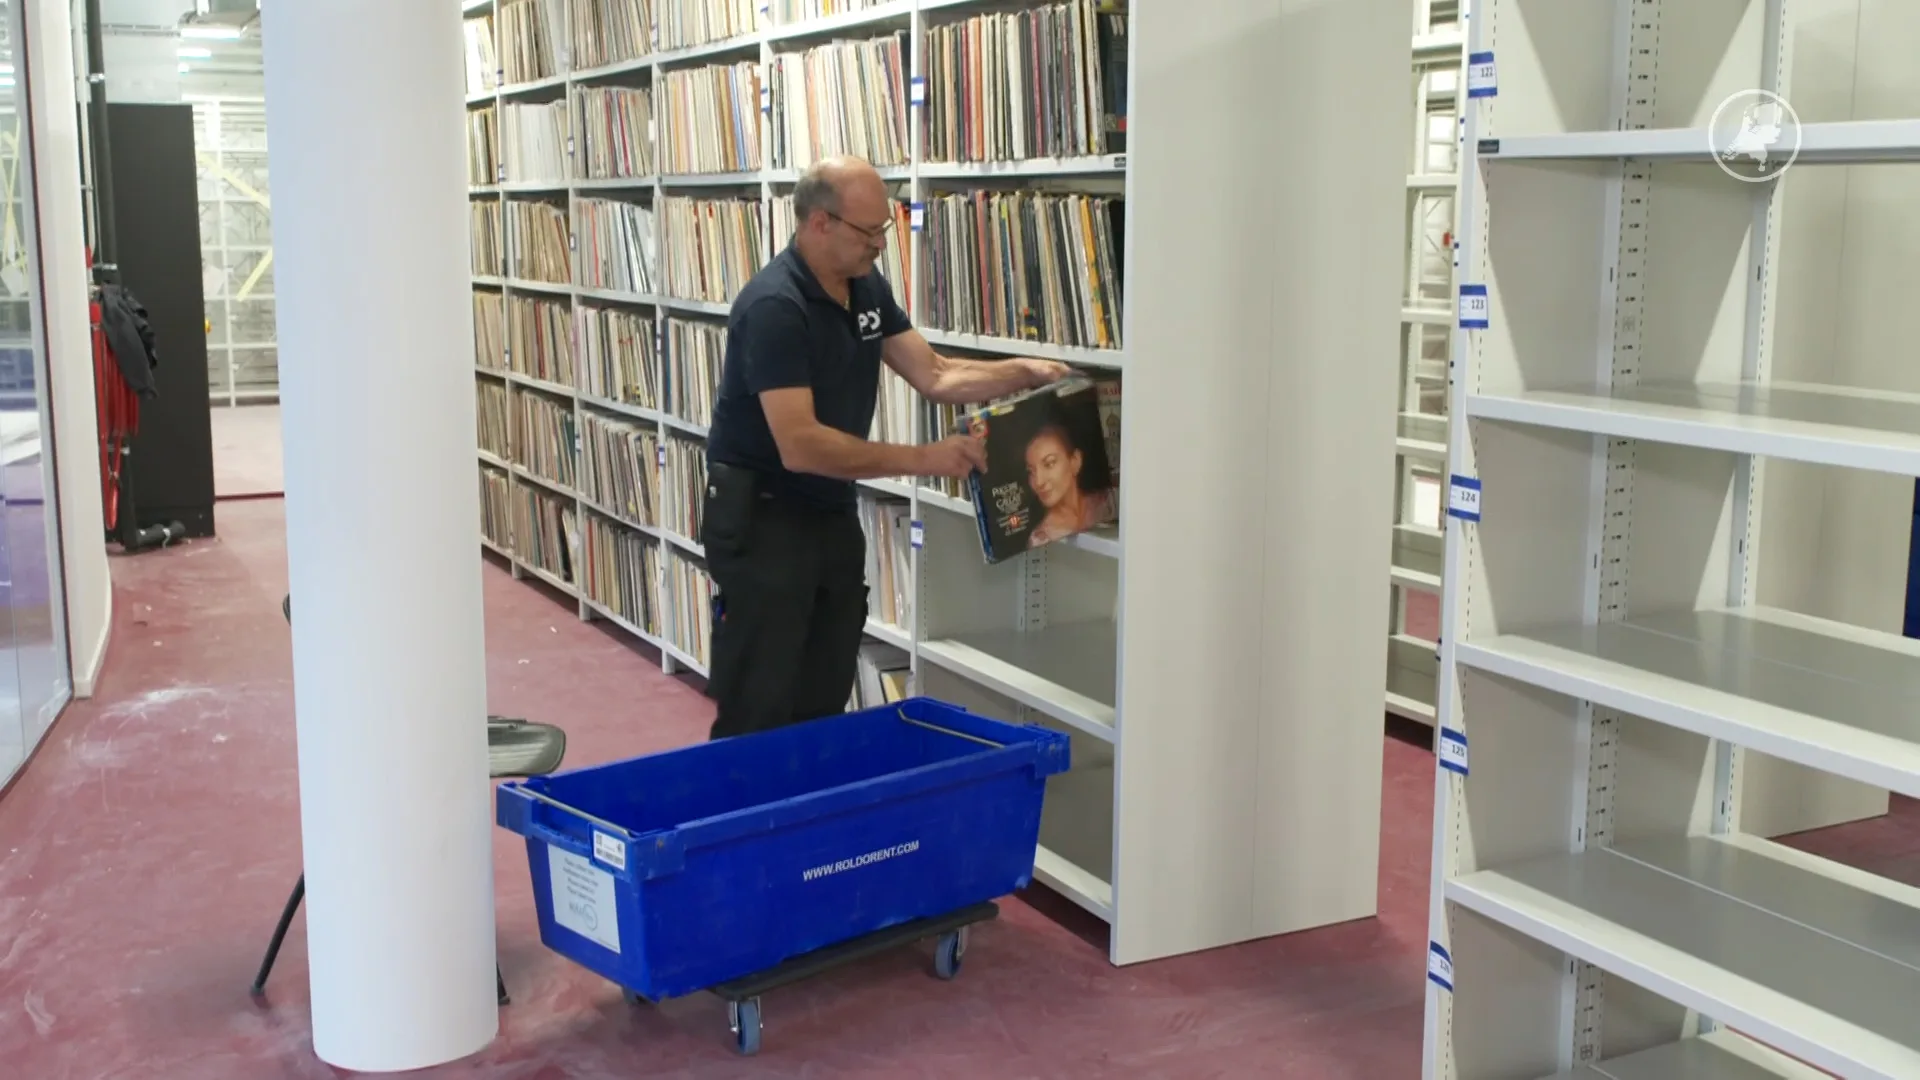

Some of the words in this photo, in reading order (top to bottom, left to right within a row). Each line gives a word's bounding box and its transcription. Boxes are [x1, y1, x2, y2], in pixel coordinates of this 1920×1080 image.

[1471, 298, 1484, 310] 123
[1461, 490, 1476, 503] 124
[802, 839, 920, 882] WWW.ROLDORENT.COM
